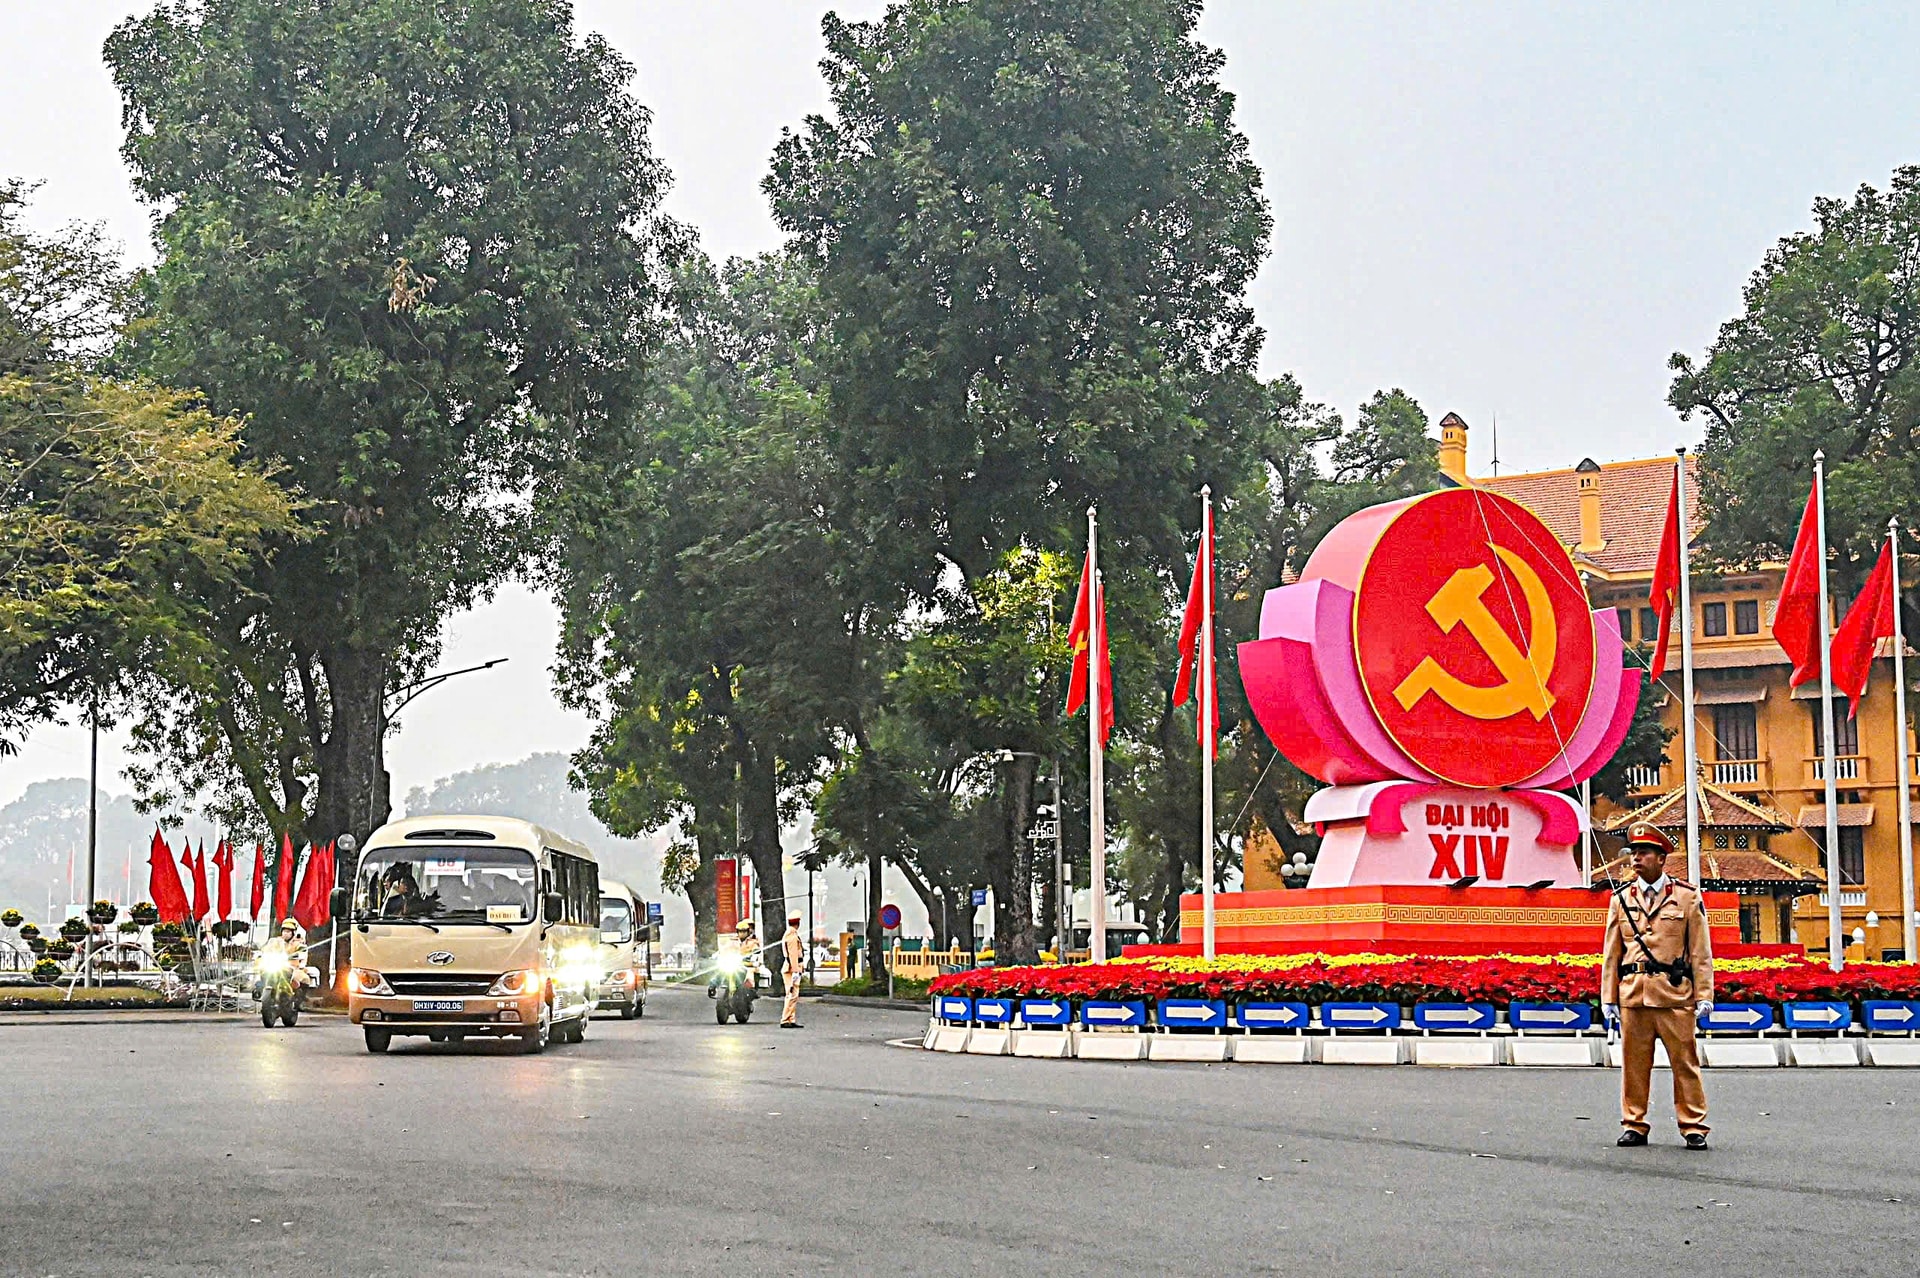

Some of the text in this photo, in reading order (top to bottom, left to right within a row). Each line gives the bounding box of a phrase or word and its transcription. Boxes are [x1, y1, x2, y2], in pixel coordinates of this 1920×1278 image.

[1426, 802, 1509, 832] ĐẠI HỘI
[1428, 834, 1509, 880] XIV
